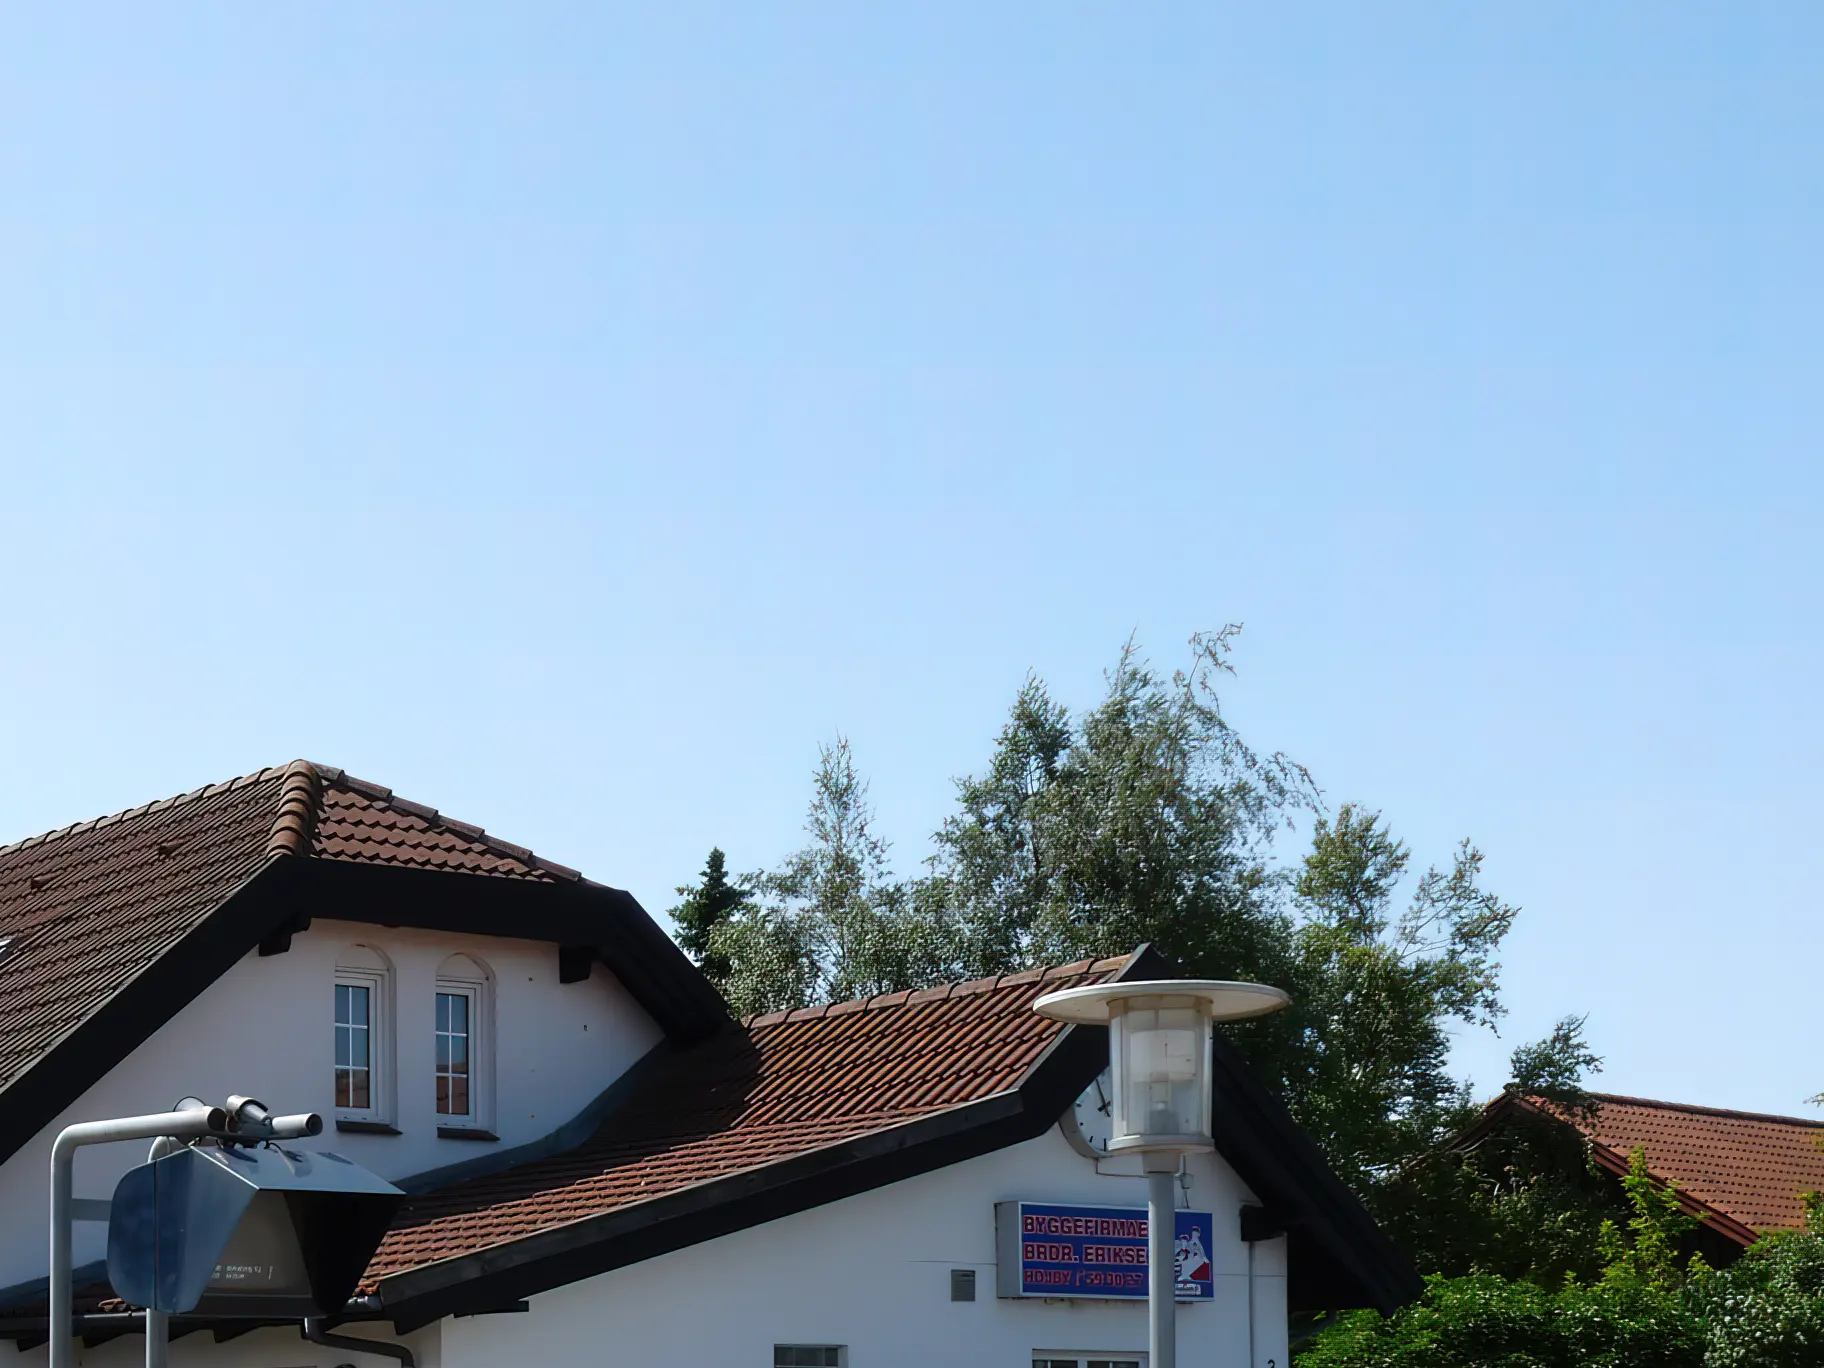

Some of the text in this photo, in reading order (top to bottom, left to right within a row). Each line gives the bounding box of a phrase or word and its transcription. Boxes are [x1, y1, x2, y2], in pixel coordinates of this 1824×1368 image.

[1023, 1215, 1149, 1238] BYGGEFIRMAE
[1023, 1242, 1149, 1265] BRDR. ERIKSE
